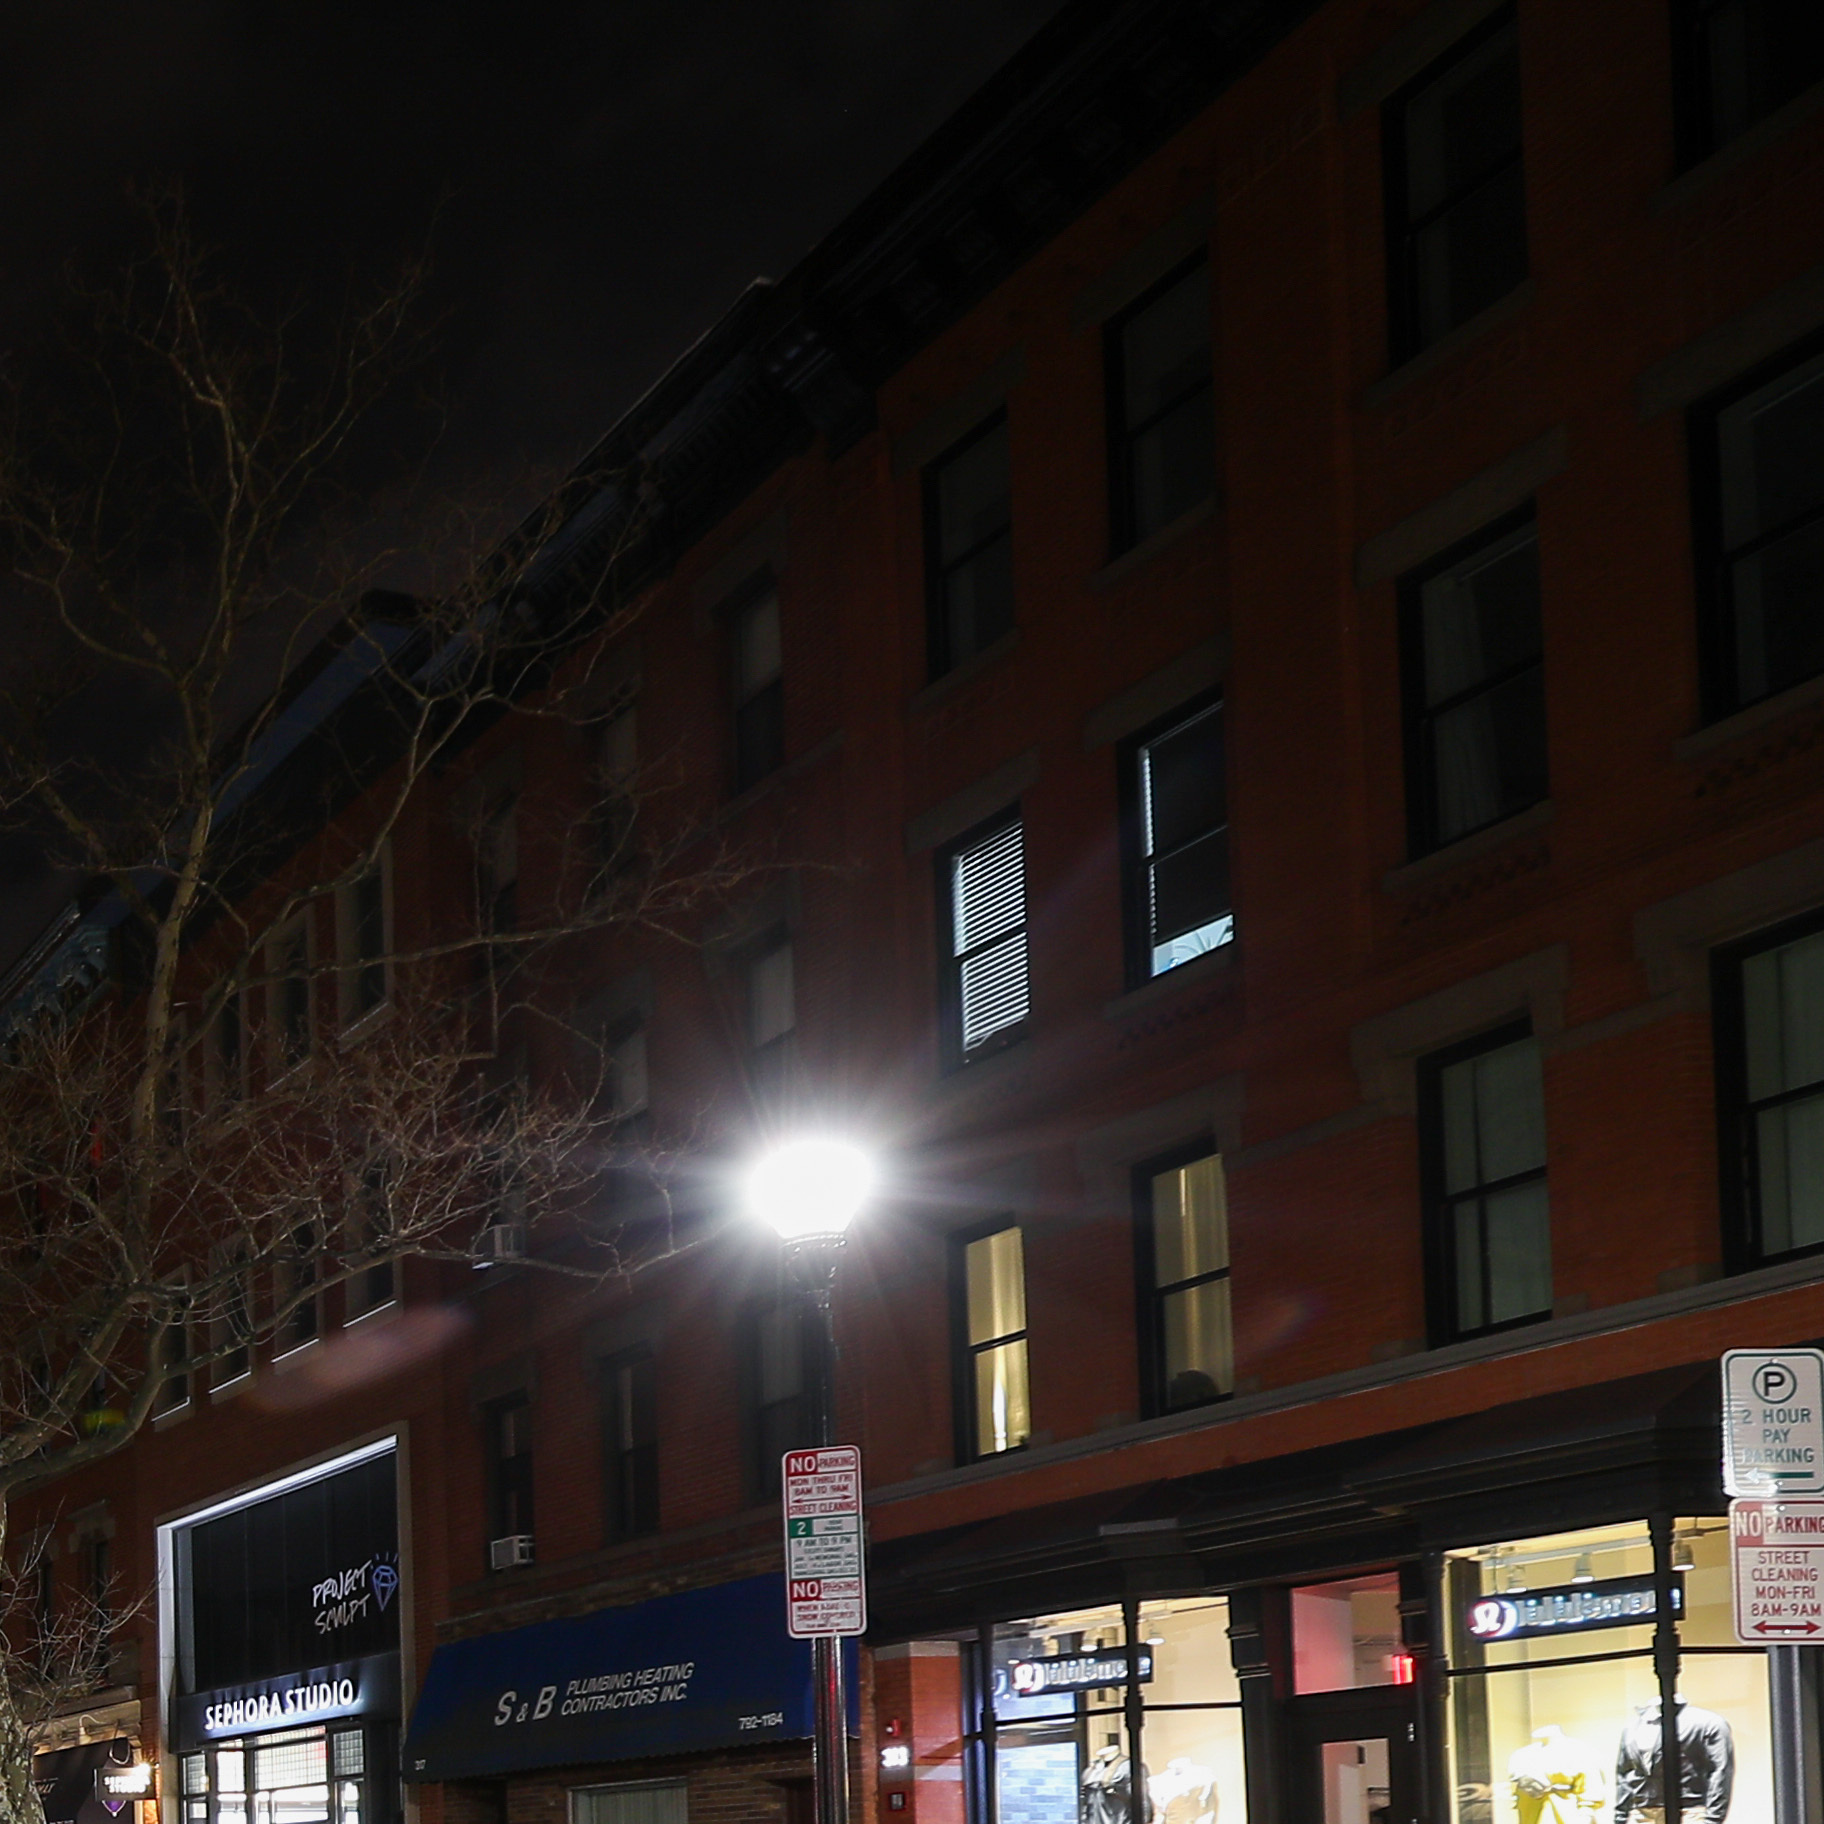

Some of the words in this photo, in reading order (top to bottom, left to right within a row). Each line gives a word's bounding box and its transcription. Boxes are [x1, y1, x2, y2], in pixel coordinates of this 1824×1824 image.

[1763, 1371, 1786, 1396] P
[1741, 1409, 1753, 1423] 2
[1763, 1408, 1811, 1423] HOUR
[1763, 1428, 1790, 1443] PAY
[1743, 1448, 1814, 1463] PARKING
[790, 1456, 816, 1473] NO
[819, 1456, 856, 1468] PARKING
[812, 1475, 836, 1483] THRU
[816, 1486, 827, 1494] TO
[790, 1504, 816, 1514] STREET
[819, 1501, 857, 1512] CLEANING
[797, 1521, 807, 1535] 2
[1735, 1511, 1761, 1536] NO
[1765, 1516, 1824, 1533] PARKING
[1758, 1551, 1810, 1564] STREET
[1752, 1568, 1818, 1581] CLEANING
[312, 1560, 372, 1608] PROJECT
[792, 1581, 819, 1598] NO
[1756, 1586, 1815, 1599] MON-FRI
[314, 1593, 371, 1634] SCULPT
[1751, 1603, 1822, 1616] 8AM-9AM
[566, 1672, 632, 1697] PLUMBING
[634, 1662, 695, 1687] HEATING
[204, 1692, 283, 1731] SEPHORA
[284, 1678, 353, 1715] STUDIO
[494, 1690, 518, 1727] S
[516, 1702, 529, 1723] &
[533, 1685, 557, 1721] B
[561, 1687, 658, 1716] CONTRACTORS
[659, 1682, 688, 1703] INC.
